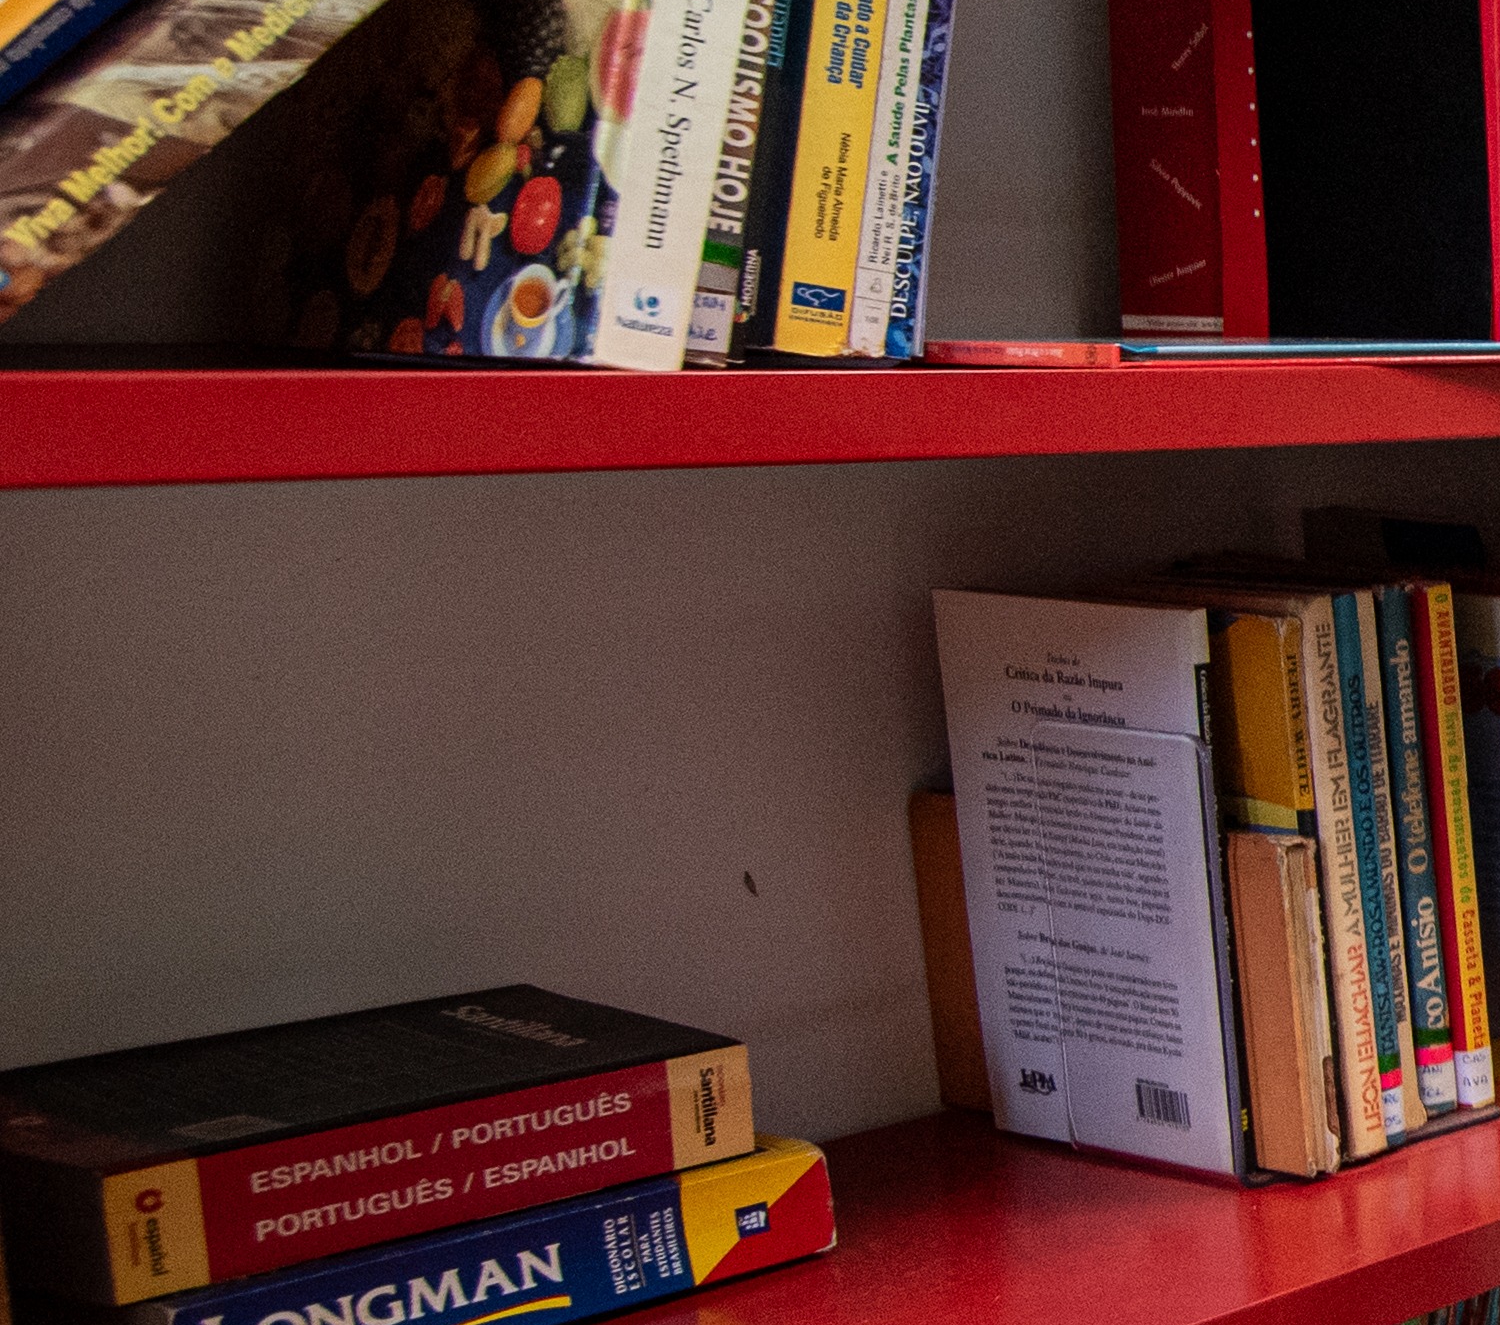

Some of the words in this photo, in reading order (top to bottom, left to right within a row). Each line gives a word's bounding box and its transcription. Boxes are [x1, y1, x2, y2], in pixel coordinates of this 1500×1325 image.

[835, 1, 854, 17] da
[826, 20, 852, 86] Criança
[847, 37, 874, 89] Cuidar
[895, 56, 911, 96] Pelas
[669, 76, 694, 106] N.
[888, 100, 906, 148] Saúde
[4, 199, 74, 250] Viva
[59, 121, 160, 207] Melhor!
[153, 78, 217, 127] Com
[643, 113, 694, 251] Spethmann
[832, 164, 848, 196] Maria
[886, 155, 899, 166] A
[887, 175, 901, 202] Brito
[897, 159, 924, 206] NÃO
[705, 152, 740, 235] HOJE
[812, 181, 831, 239] Figueiredo
[827, 197, 844, 242] Almeida
[869, 218, 885, 264] Ricardo
[888, 209, 919, 318] DESCULPE,
[741, 248, 760, 307] MODERNA
[1438, 592, 1450, 603] O
[1005, 666, 1040, 684] Crítica
[1041, 670, 1055, 684] da
[1056, 671, 1086, 687] Razão
[1087, 673, 1124, 693] Impura
[1440, 610, 1459, 707] AVANTAJADO
[1010, 700, 1022, 714] O
[1023, 702, 1064, 719] Primado
[1064, 706, 1077, 720] da
[1078, 709, 1127, 726] Ignorância
[1286, 654, 1303, 724] PERRY
[1317, 623, 1343, 767] FLAGRANTE
[1347, 674, 1362, 761] OUTROS
[1390, 639, 1418, 745] amarelo
[1293, 726, 1311, 797] WHITE
[1445, 711, 1460, 756] livro
[1330, 768, 1349, 814] EM
[1354, 765, 1370, 795] OS
[1371, 771, 1385, 790] DE
[1400, 747, 1427, 843] telefone
[1449, 760, 1462, 776] de
[1354, 798, 1370, 808] E
[1449, 778, 1469, 879] pensamentos
[1336, 816, 1358, 915] MULHER
[1360, 816, 1385, 945] ROSAMUNDO
[1406, 844, 1428, 874] O
[1345, 918, 1360, 935] A
[1412, 896, 1445, 994] Anísio
[1462, 908, 1480, 969] Casseta
[1347, 944, 1374, 1063] ELIACHAR
[1468, 977, 1480, 989] &
[1469, 993, 1486, 1051] Planeta
[699, 1065, 716, 1147] Santillana
[1358, 1066, 1382, 1131] LEON
[250, 1137, 424, 1196] ESPANHOL
[430, 1132, 443, 1157] /
[450, 1089, 634, 1151] PORTUGUÊS
[254, 1177, 453, 1244] PORTUGUÊS
[463, 1171, 475, 1194] /
[483, 1134, 637, 1190] ESPANHOL
[600, 1217, 628, 1296] DICIONÁRIO
[617, 1214, 640, 1291] ESCOLAR
[638, 1231, 653, 1264] PARA
[650, 1210, 670, 1279] ESTUDANTES
[663, 1206, 684, 1276] BRASILEIROS
